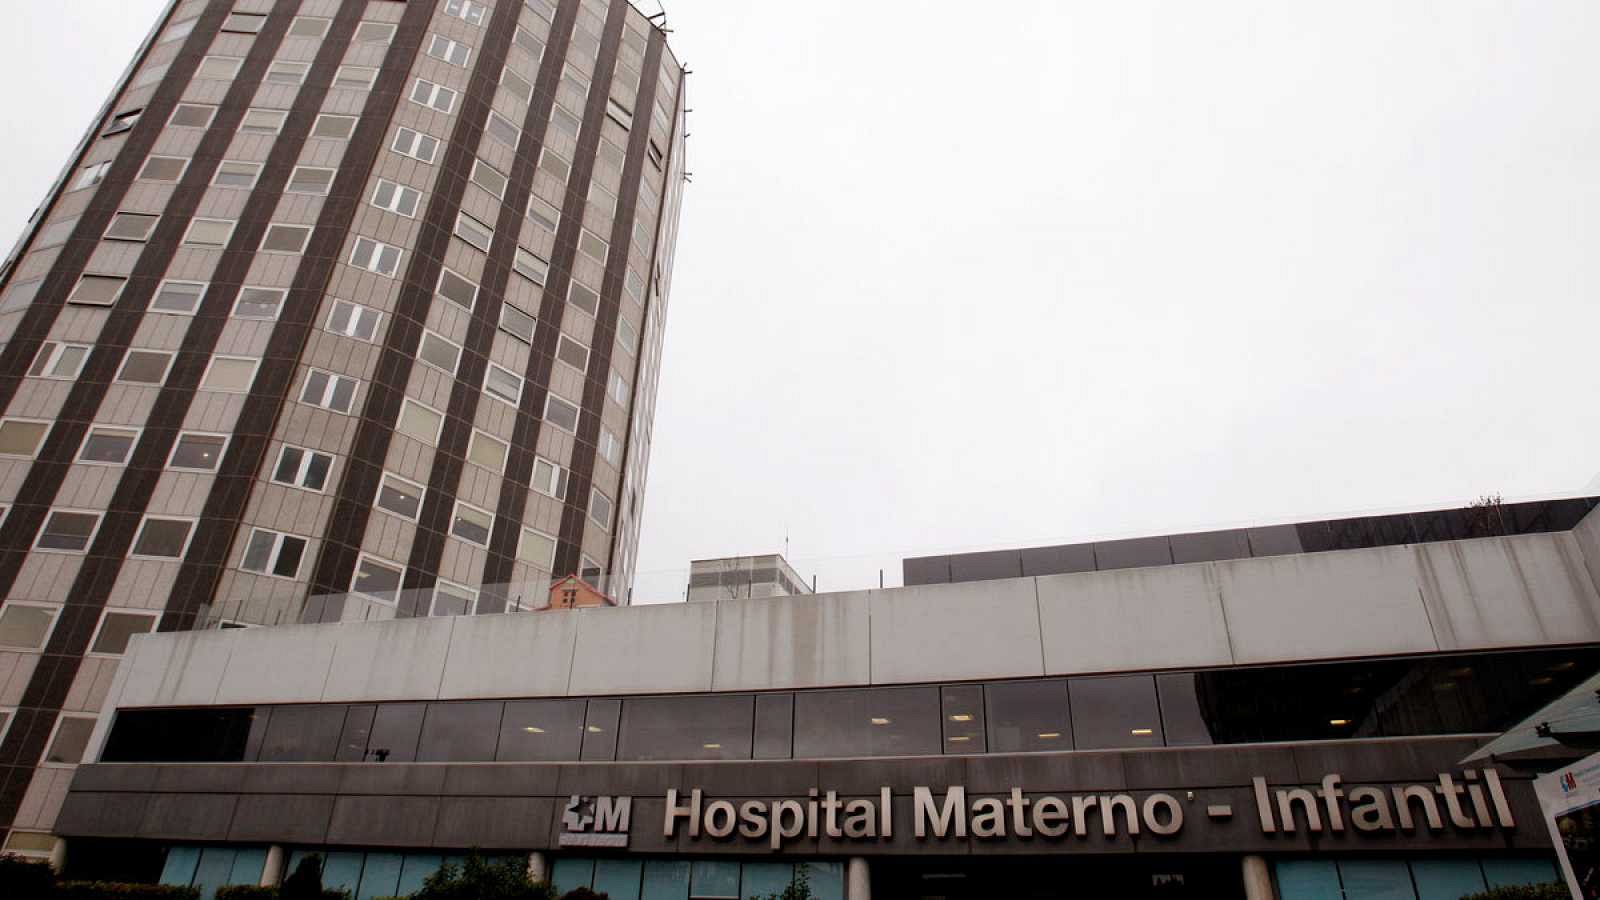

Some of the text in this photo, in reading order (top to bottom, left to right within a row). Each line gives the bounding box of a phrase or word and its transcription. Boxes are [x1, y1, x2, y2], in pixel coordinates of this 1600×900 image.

[663, 785, 893, 849] Hospital
[913, 785, 1184, 837] Materno
[1252, 767, 1516, 833] Infantil
